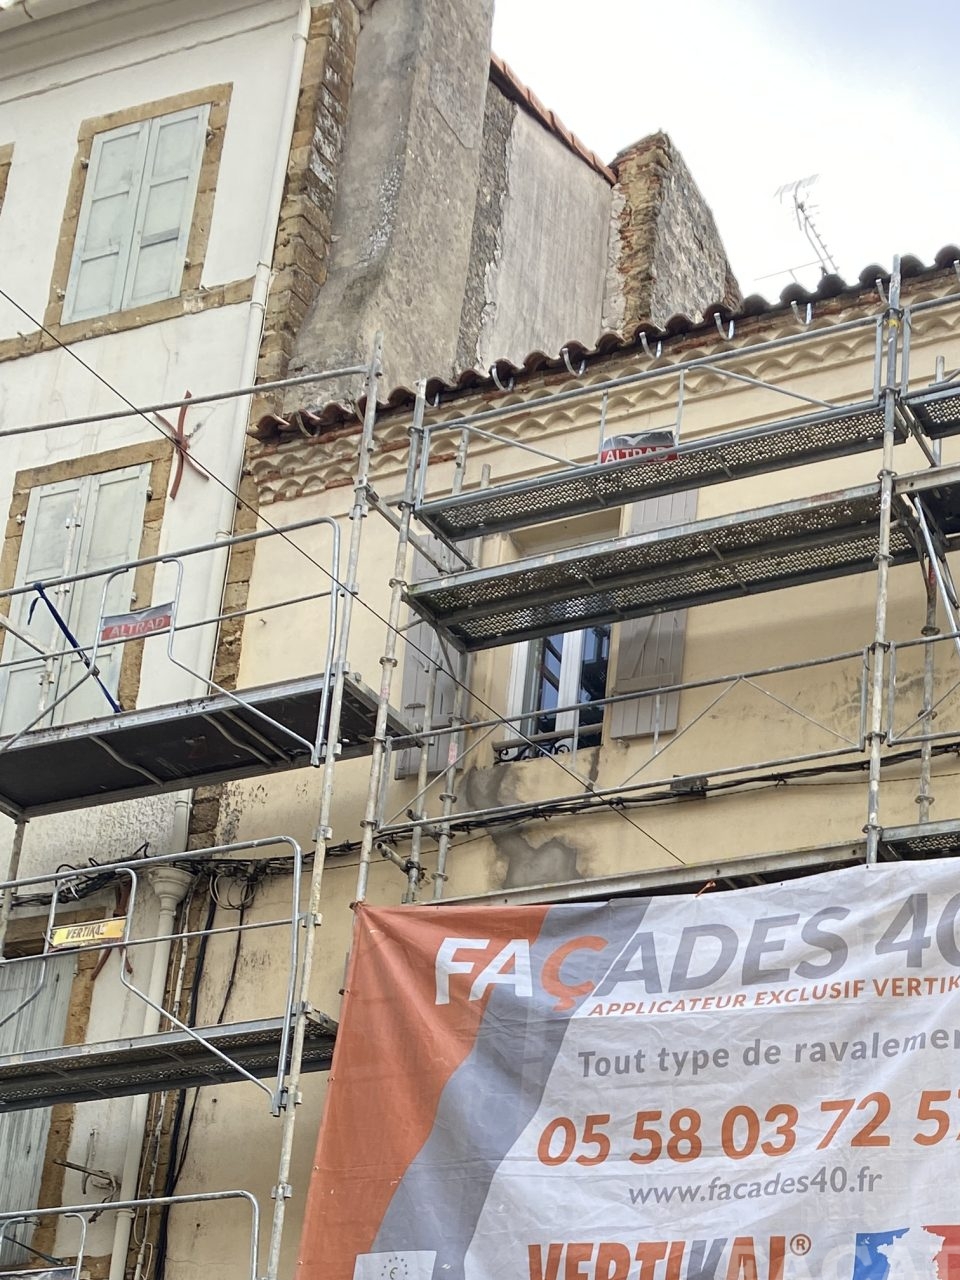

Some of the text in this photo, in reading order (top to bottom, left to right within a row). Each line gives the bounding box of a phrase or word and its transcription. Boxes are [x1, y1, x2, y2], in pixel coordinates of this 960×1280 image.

[109, 617, 165, 637] ALTRAD
[434, 905, 851, 1013] FAÇADES
[588, 994, 746, 1016] APPLICATEUR
[753, 979, 866, 1006] EXCLUSIF
[578, 1048, 646, 1077] Tout
[657, 1045, 730, 1075] type
[742, 1039, 781, 1067] de
[537, 1114, 611, 1166] 05
[628, 1108, 703, 1165] 58
[721, 1104, 799, 1160] 03
[816, 1091, 891, 1150] 72
[628, 1166, 883, 1205] www.facades40.fr
